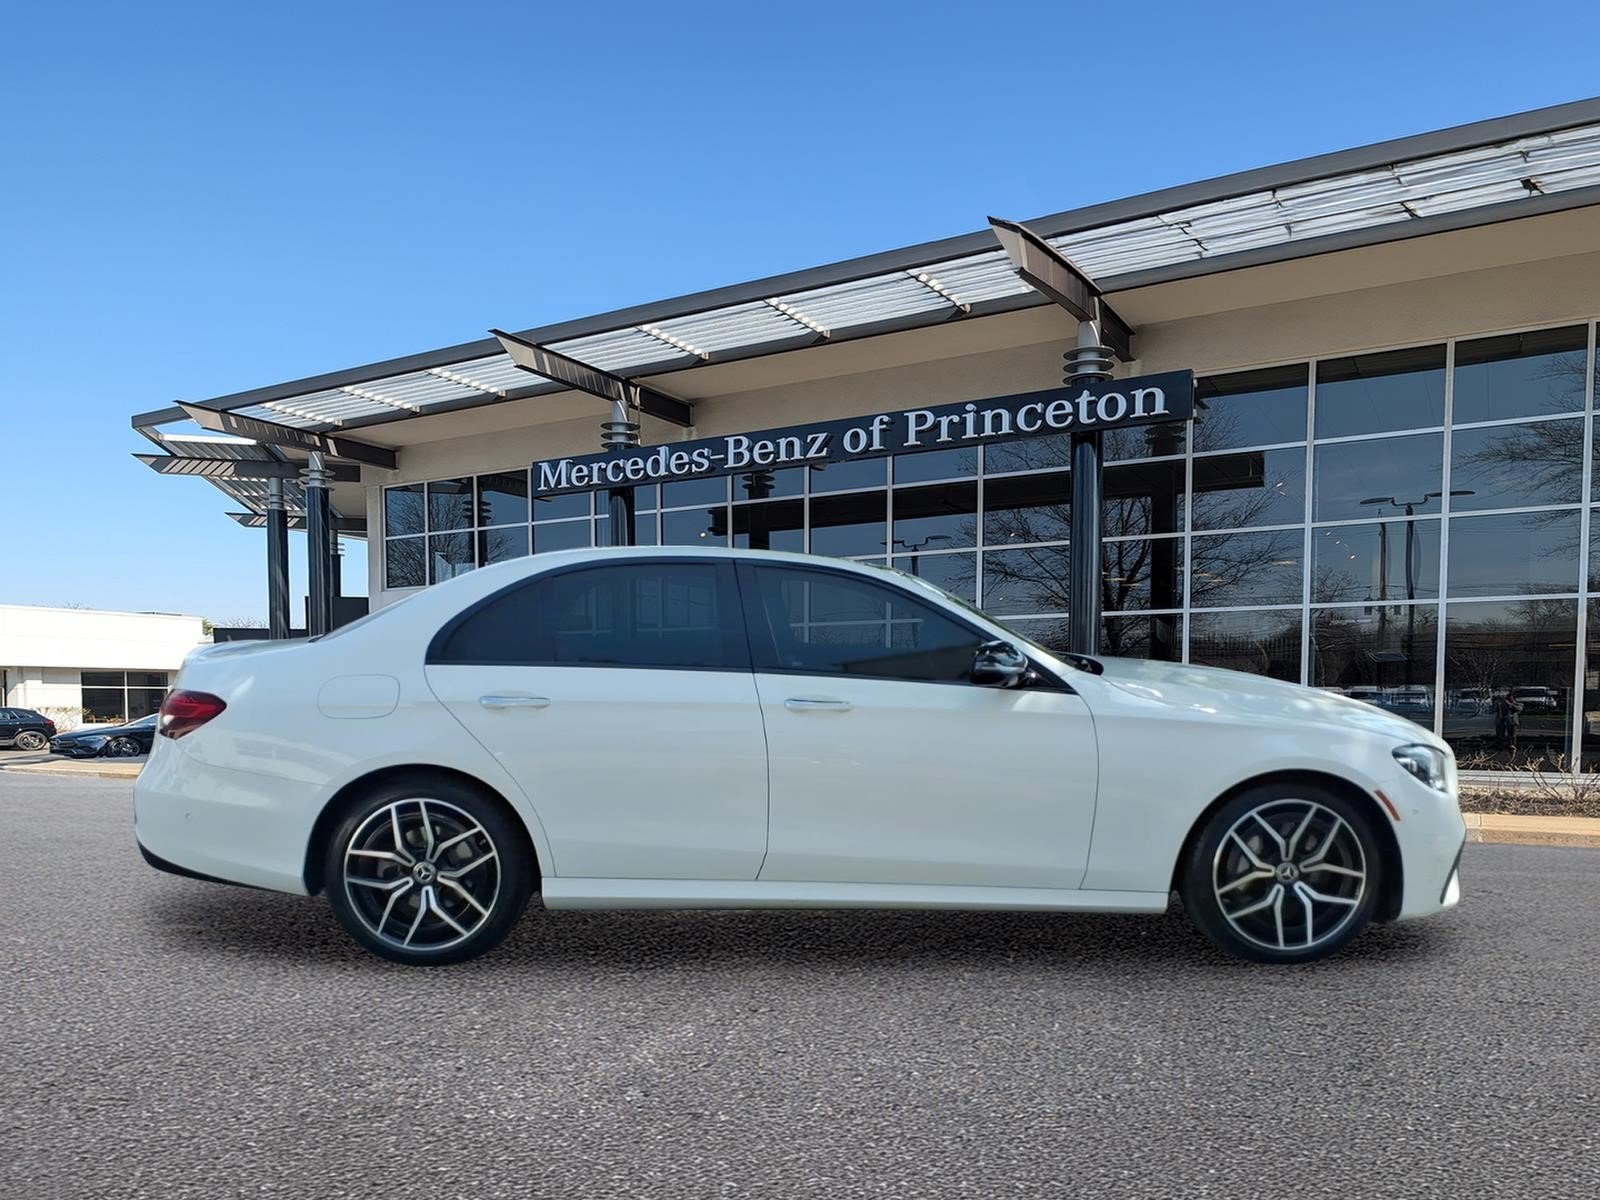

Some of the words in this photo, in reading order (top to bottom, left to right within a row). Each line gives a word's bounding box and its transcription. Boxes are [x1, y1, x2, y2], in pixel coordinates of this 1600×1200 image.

[536, 431, 830, 493] Mercedes-Benz
[842, 414, 891, 455] of
[903, 386, 1171, 448] Princeton
